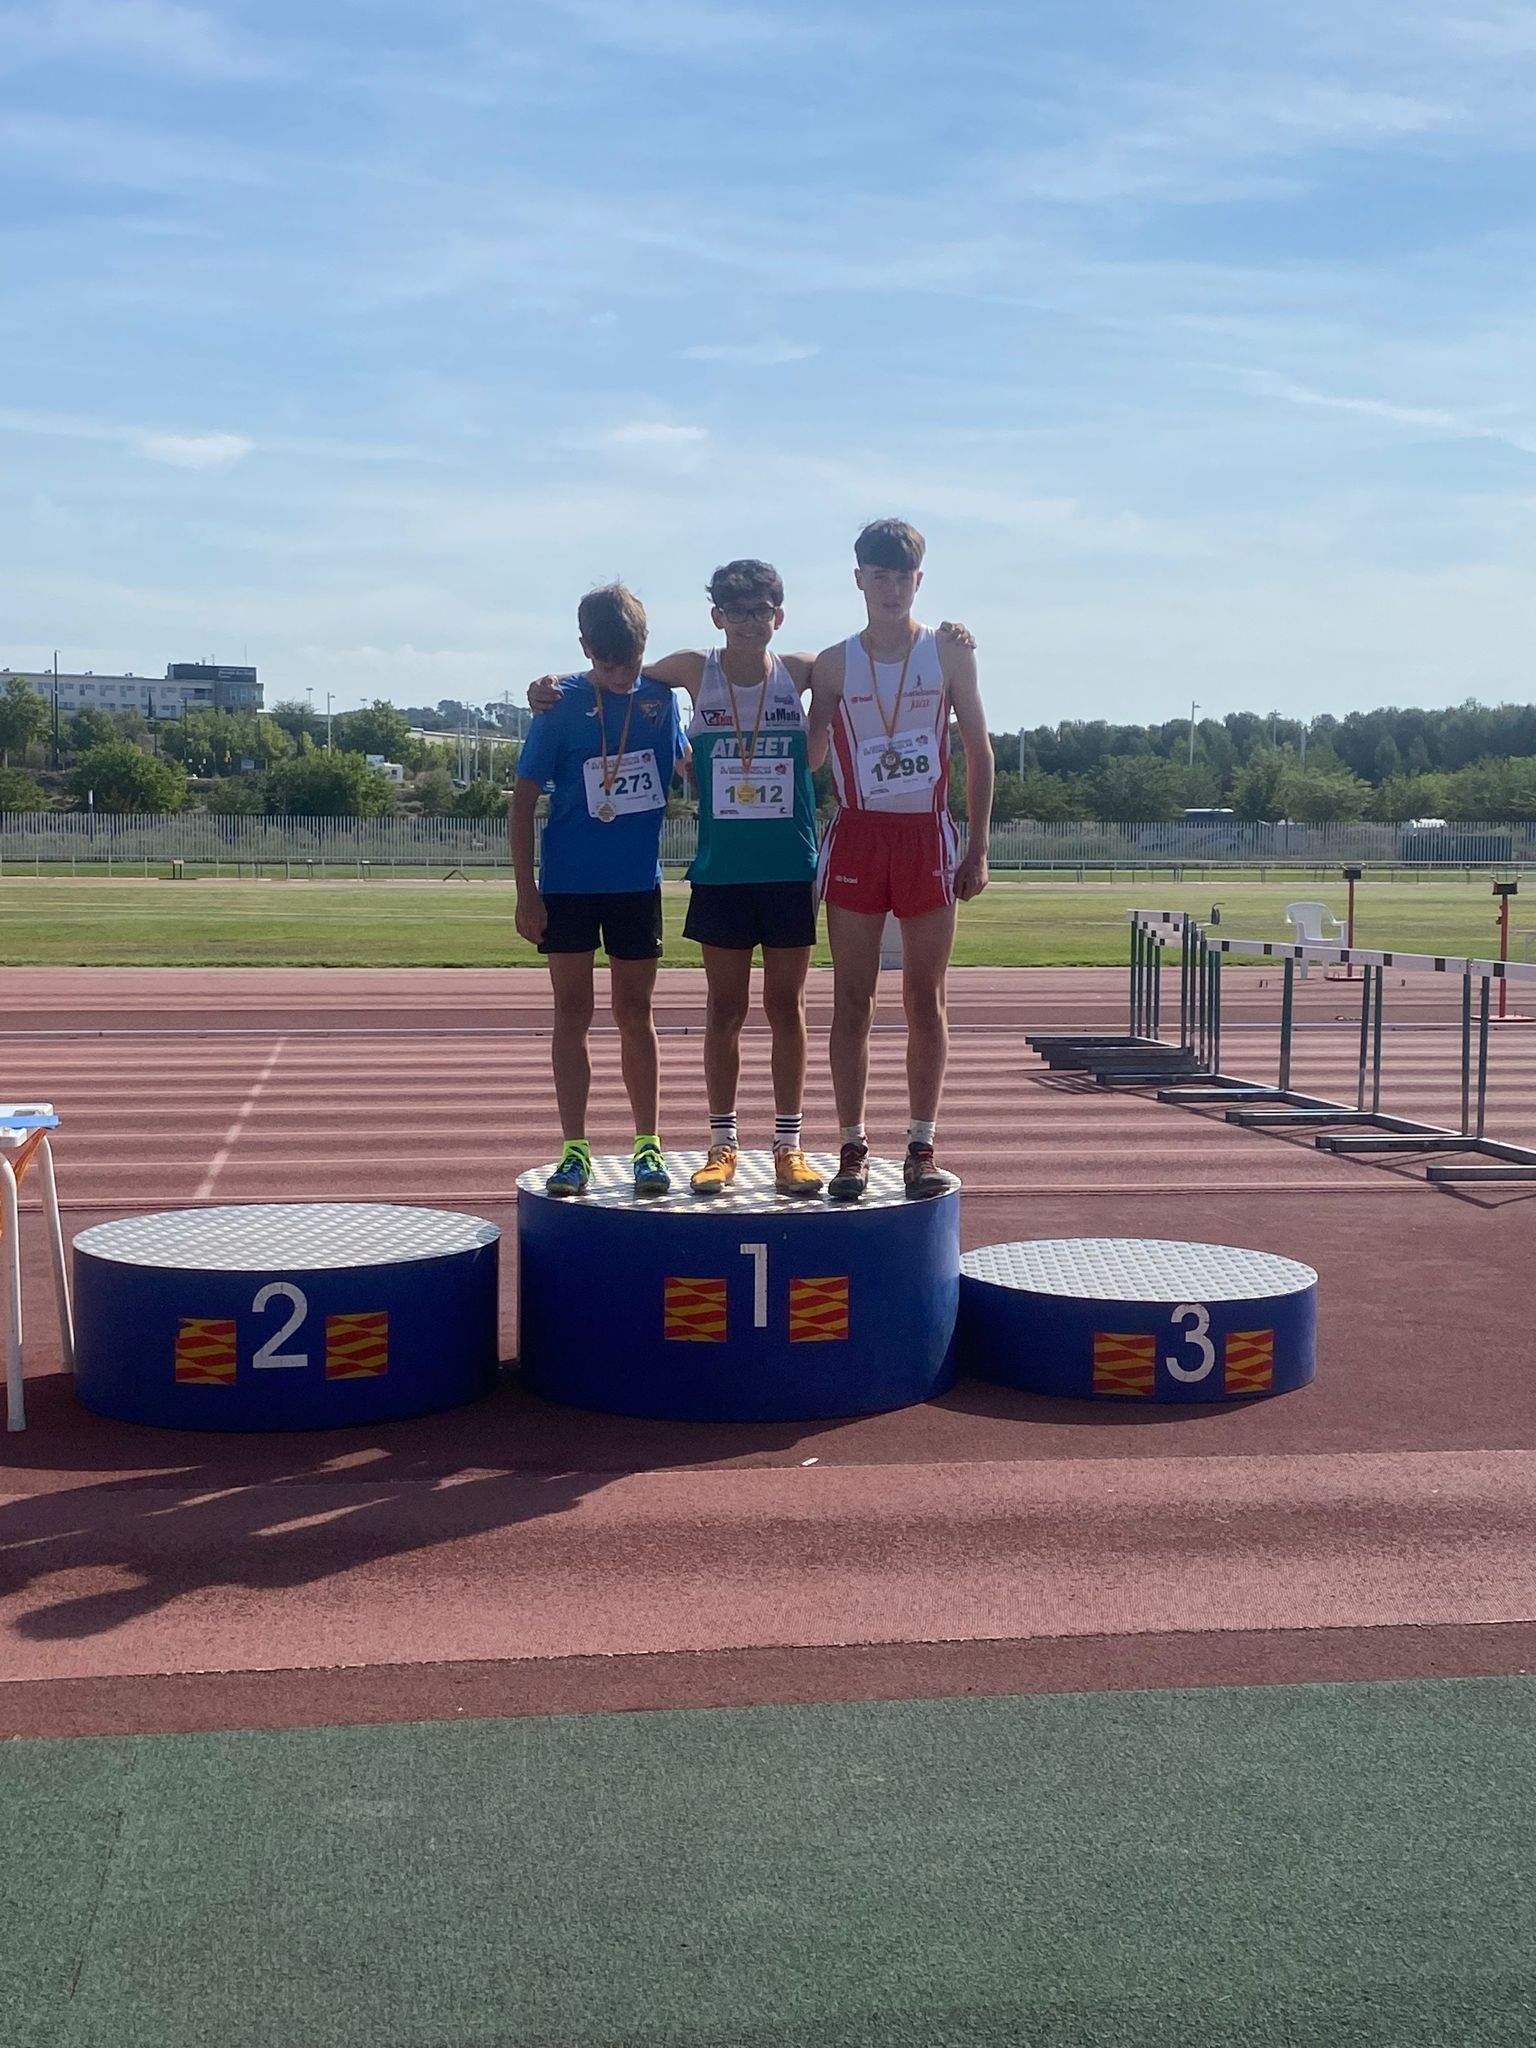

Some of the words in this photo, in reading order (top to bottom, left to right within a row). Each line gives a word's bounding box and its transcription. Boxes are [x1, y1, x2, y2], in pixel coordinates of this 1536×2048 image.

[598, 772, 653, 797] 273
[725, 785, 783, 804] 112
[251, 1281, 309, 1369] 2
[740, 1243, 768, 1328] 1
[1166, 1302, 1216, 1384] 3
